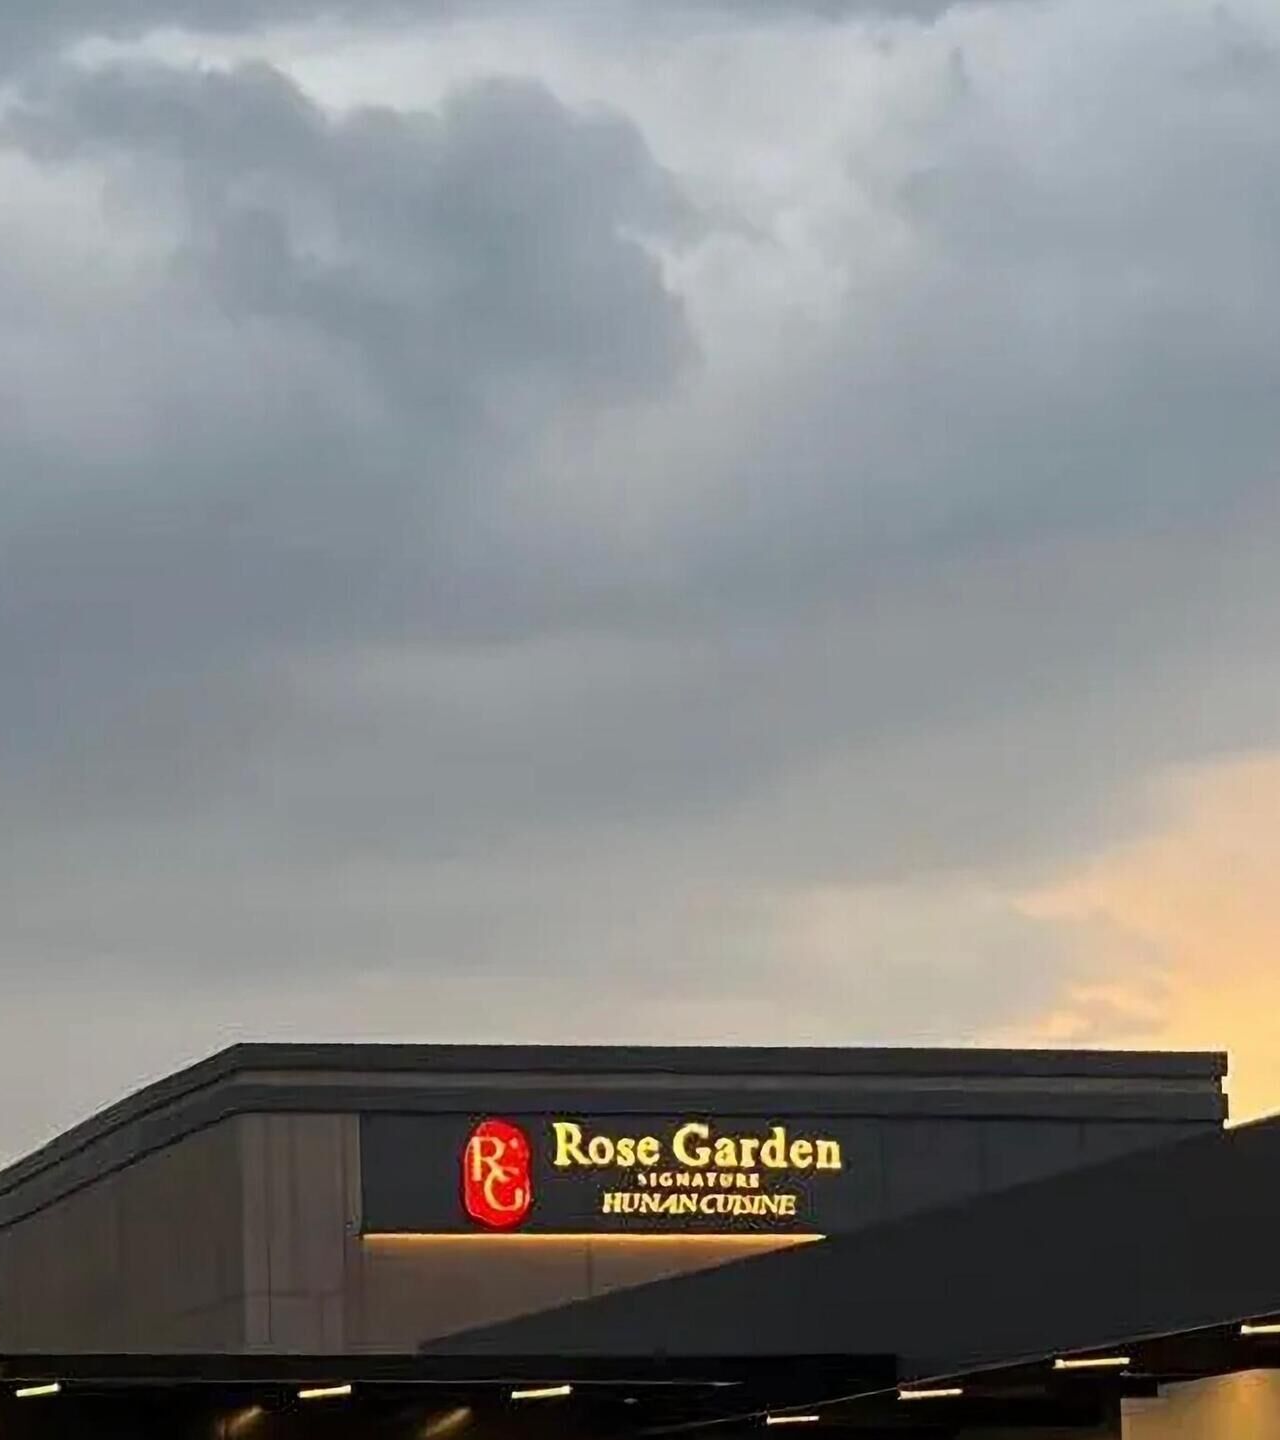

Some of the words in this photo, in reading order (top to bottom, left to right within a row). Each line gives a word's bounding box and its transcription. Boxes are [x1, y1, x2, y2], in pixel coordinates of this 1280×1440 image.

[552, 1121, 660, 1167] Rose
[672, 1121, 842, 1169] Garden
[637, 1172, 760, 1189] SIGNATURE
[601, 1191, 699, 1214] HUNAN
[700, 1193, 797, 1216] CUISINE
